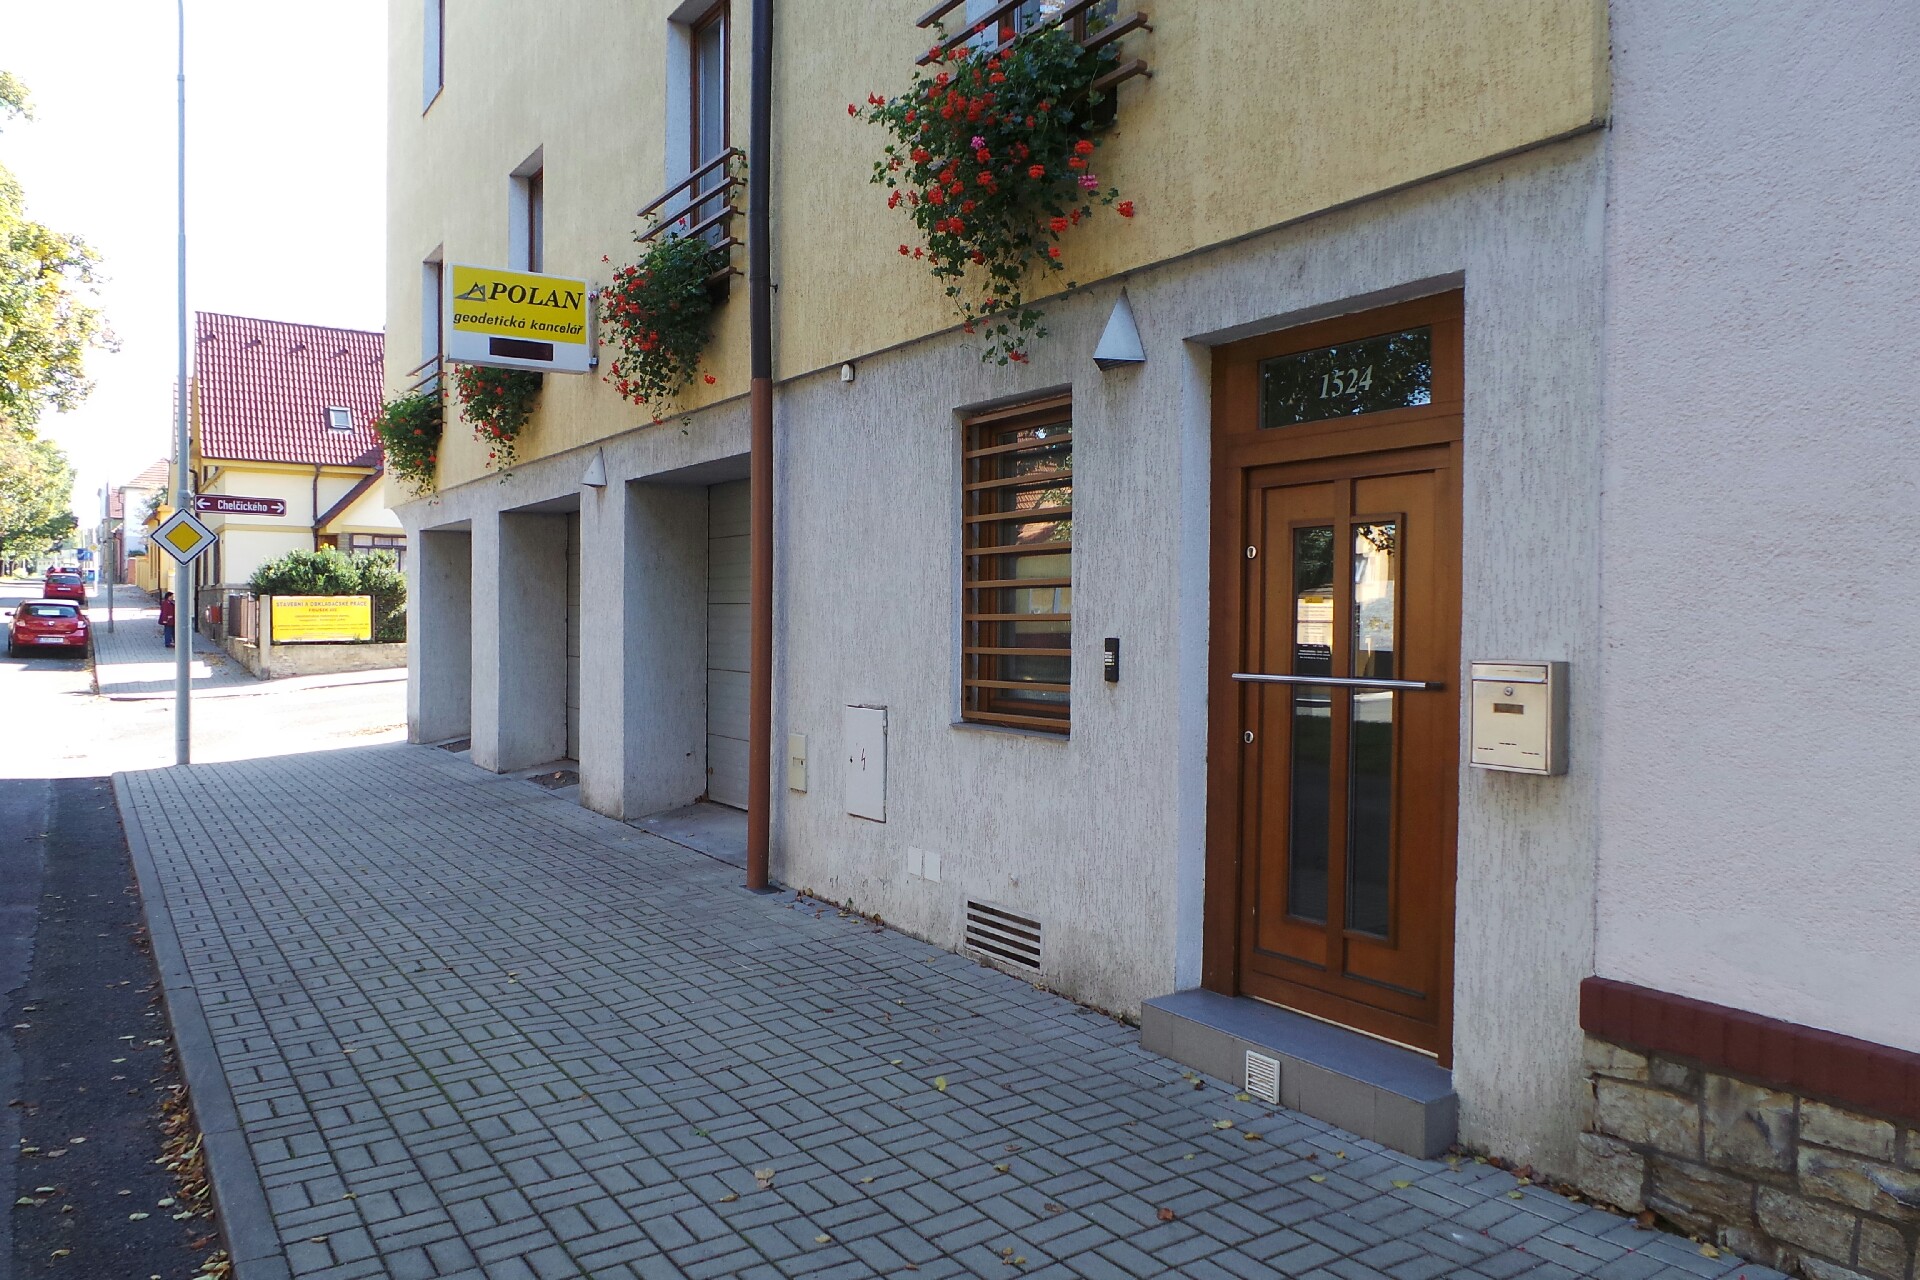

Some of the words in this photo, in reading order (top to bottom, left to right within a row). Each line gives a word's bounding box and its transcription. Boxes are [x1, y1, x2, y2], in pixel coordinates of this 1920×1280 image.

[488, 282, 583, 310] POLAN
[453, 312, 526, 329] geodetická
[530, 319, 583, 335] kancelář
[1319, 364, 1373, 399] 1524
[217, 499, 268, 512] Chelčického
